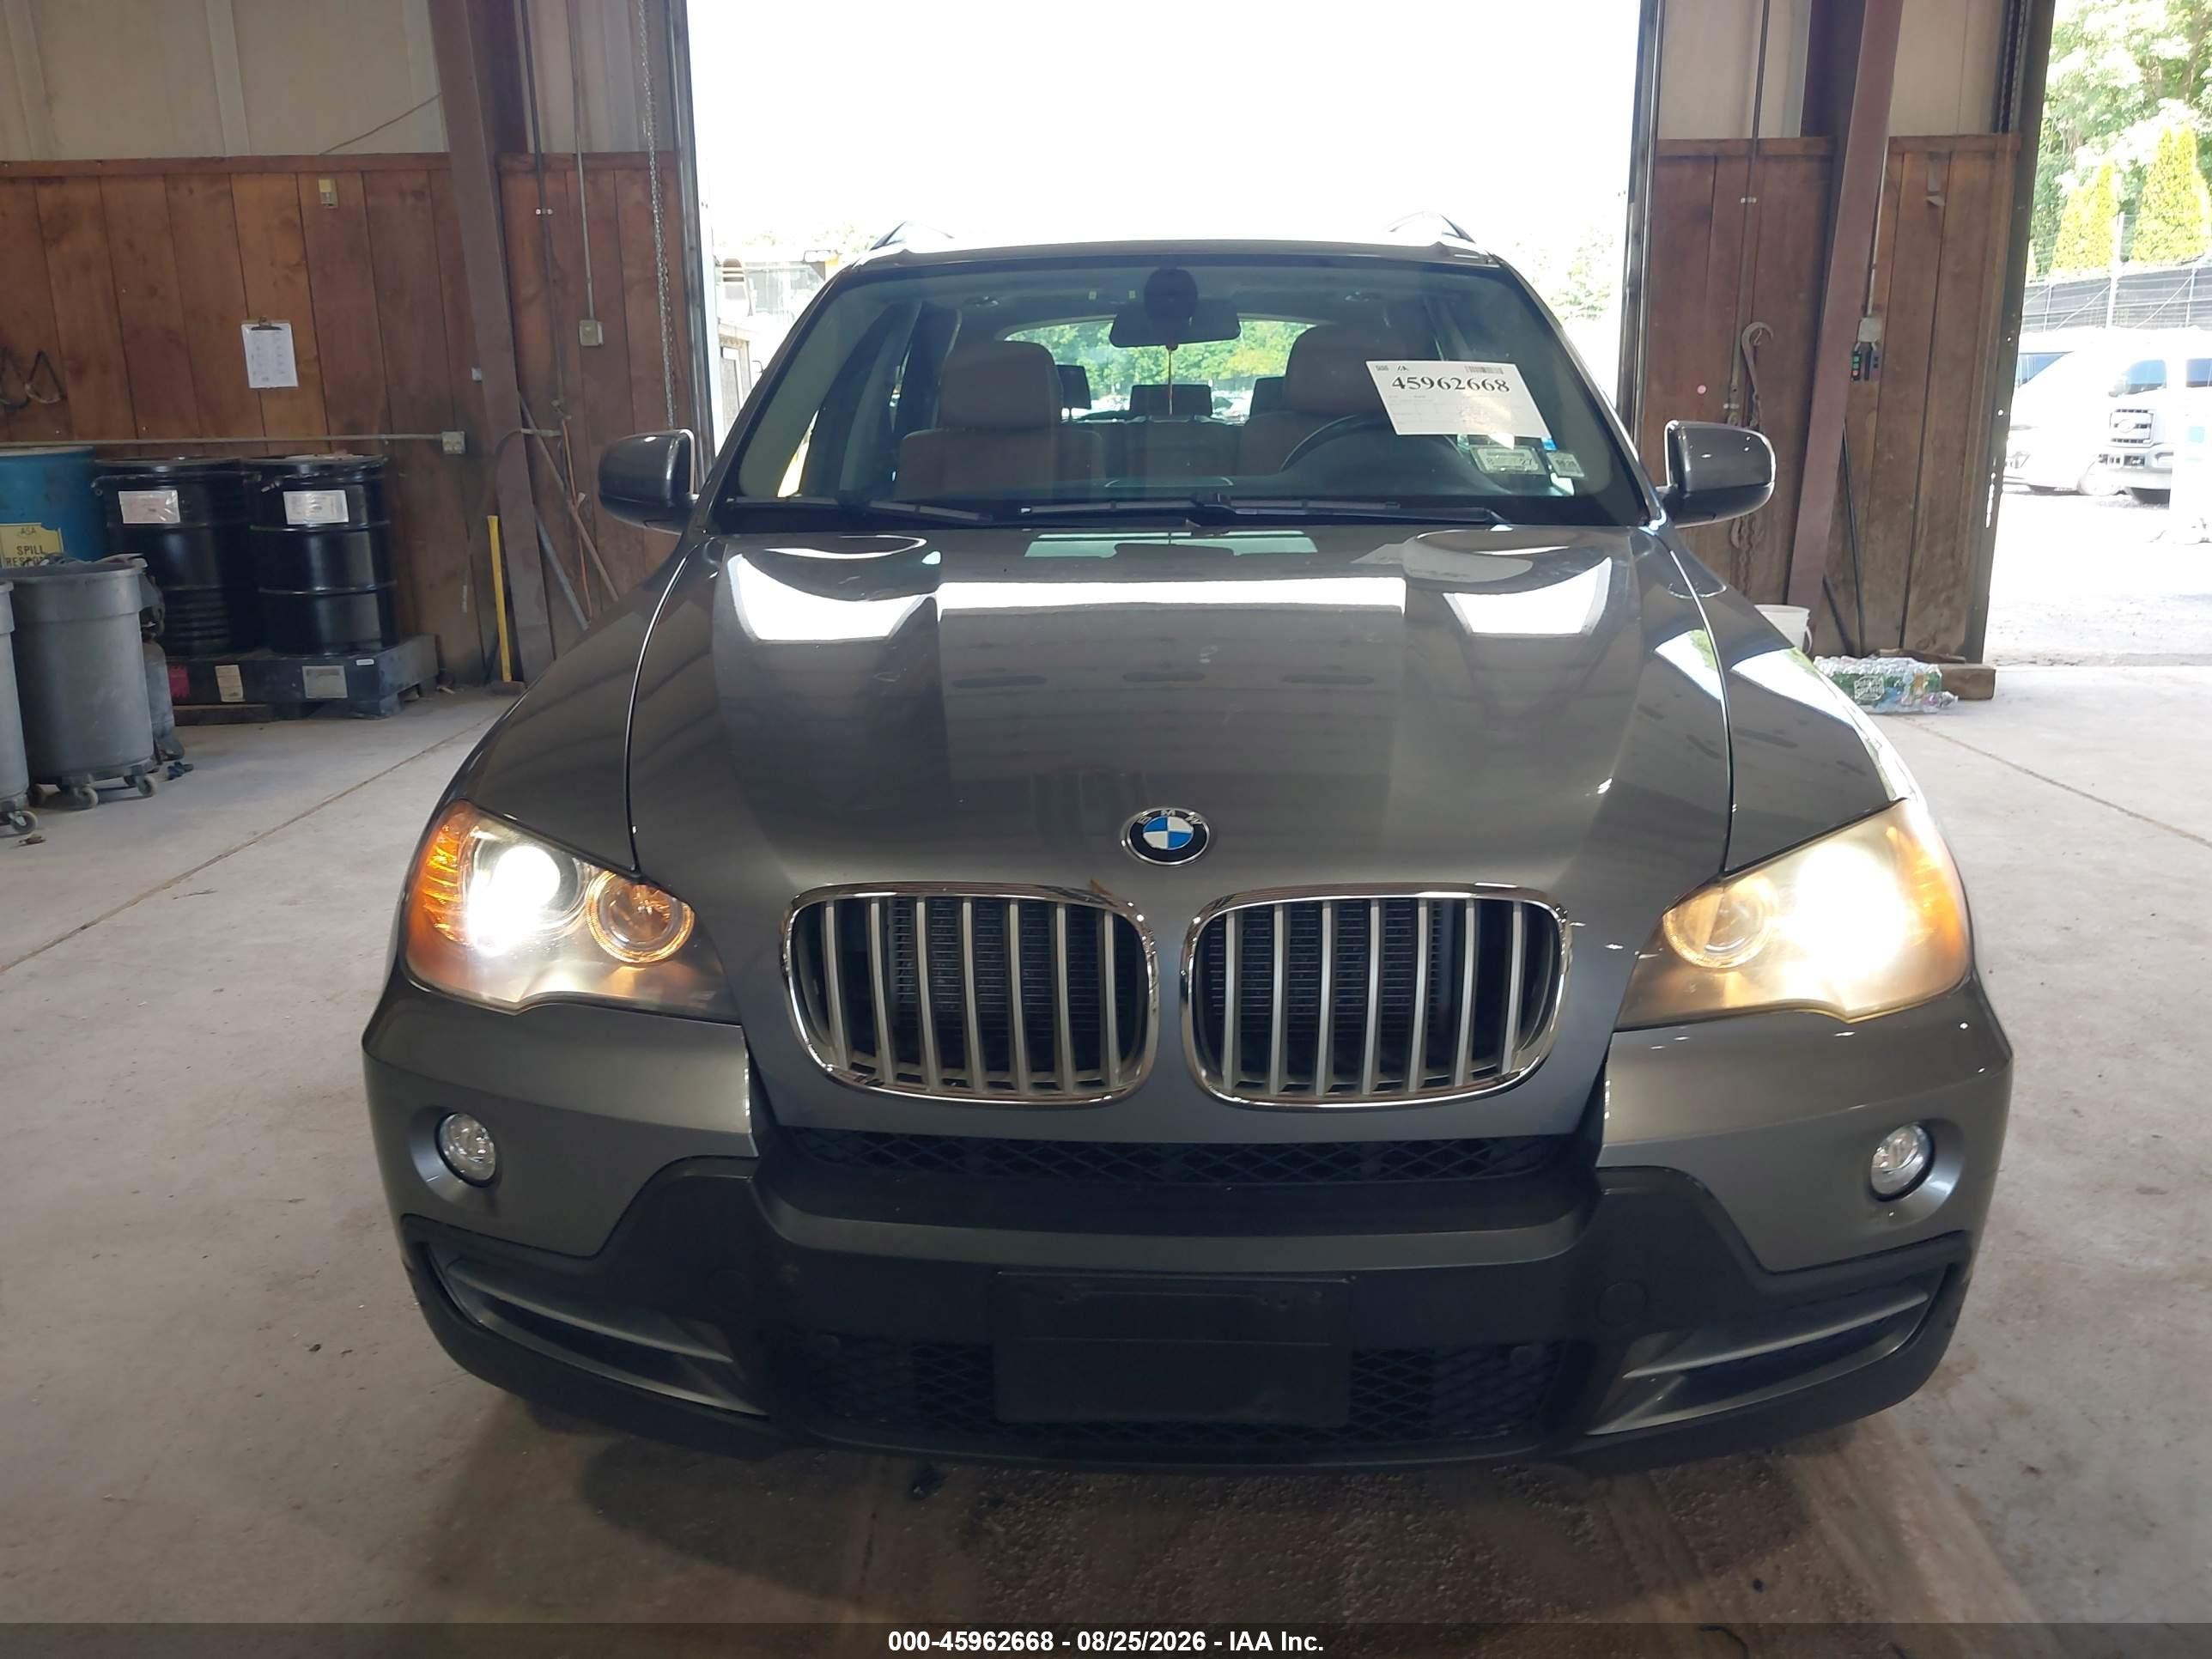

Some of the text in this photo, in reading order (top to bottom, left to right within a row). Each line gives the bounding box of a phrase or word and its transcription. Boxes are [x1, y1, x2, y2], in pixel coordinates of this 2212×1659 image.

[1391, 376, 1510, 392] 45962668
[16, 544, 44, 556] SPILL
[1136, 809, 1203, 825] BMW
